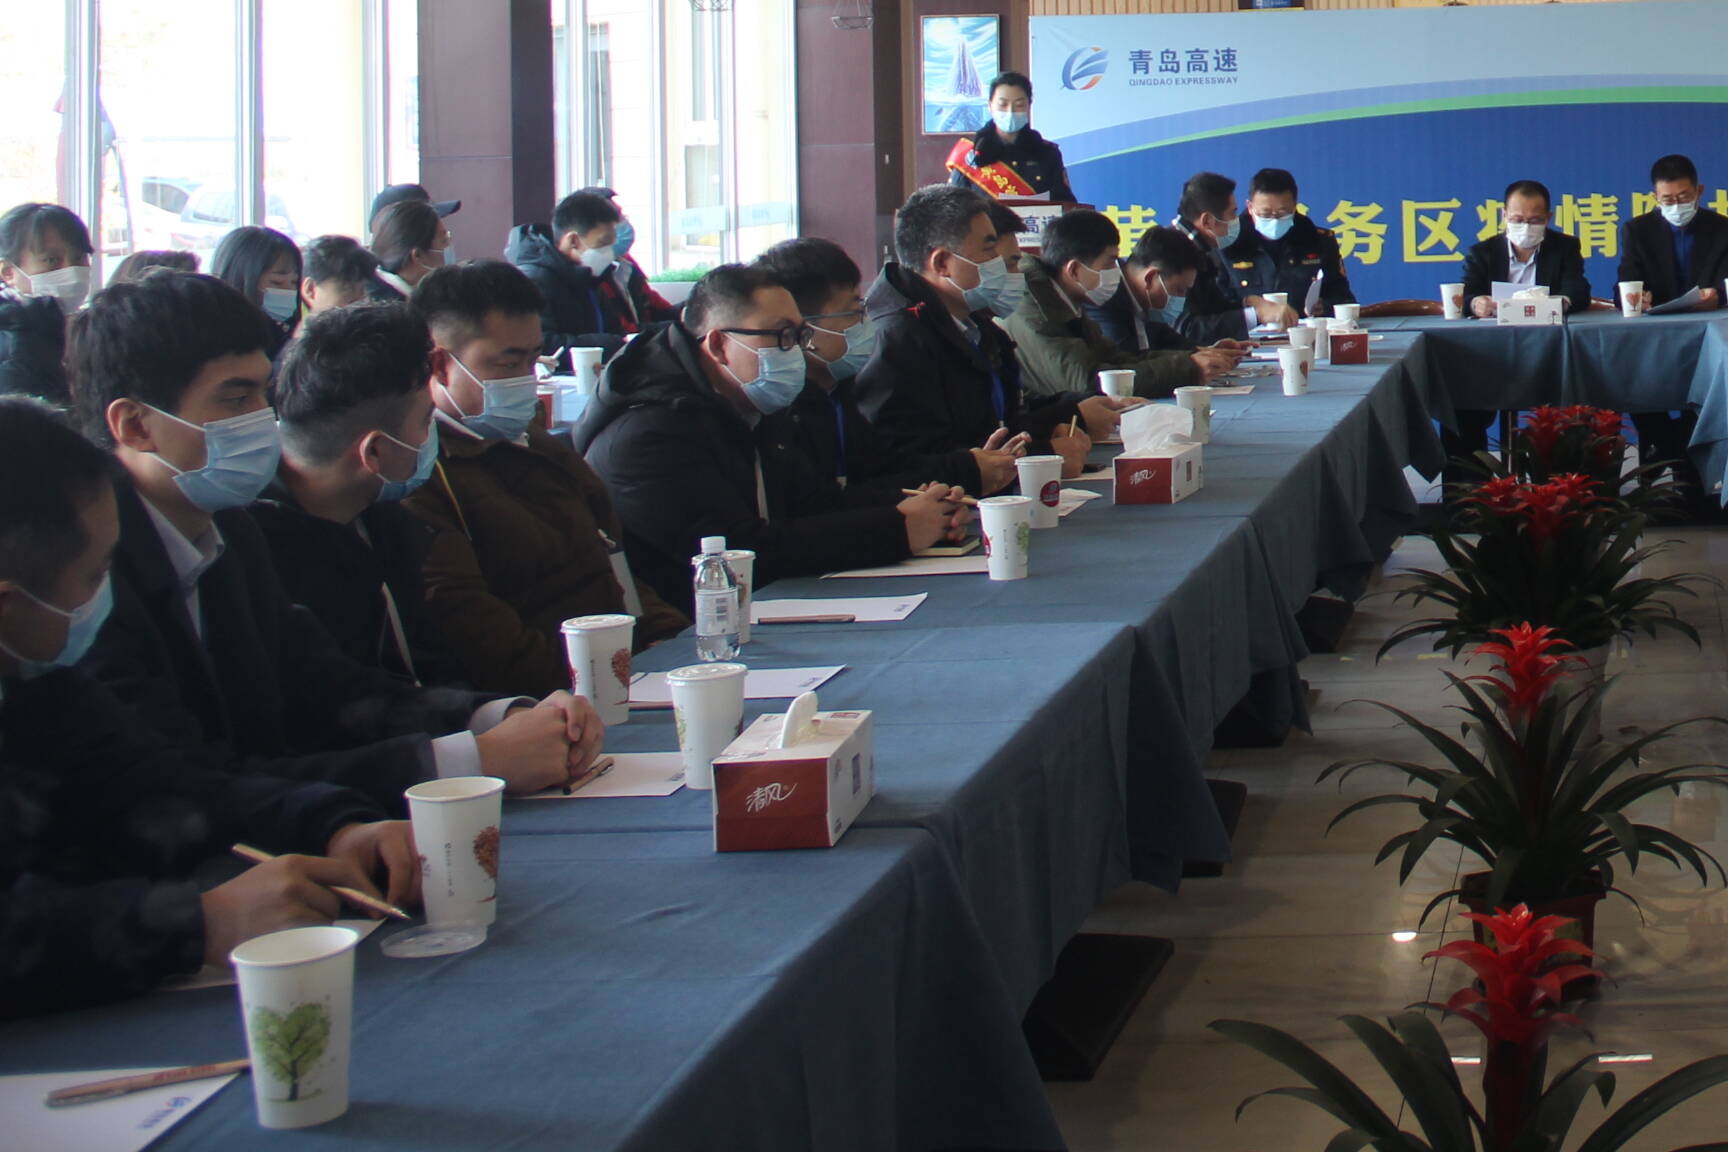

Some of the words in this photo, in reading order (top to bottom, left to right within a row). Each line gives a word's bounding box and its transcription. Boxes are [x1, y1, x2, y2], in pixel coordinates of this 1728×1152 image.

[1128, 47, 1238, 75] 青岛高速
[1128, 78, 1173, 87] QINGDAO
[1175, 76, 1239, 86] EXPRESSWAY
[746, 782, 798, 813] 清风
